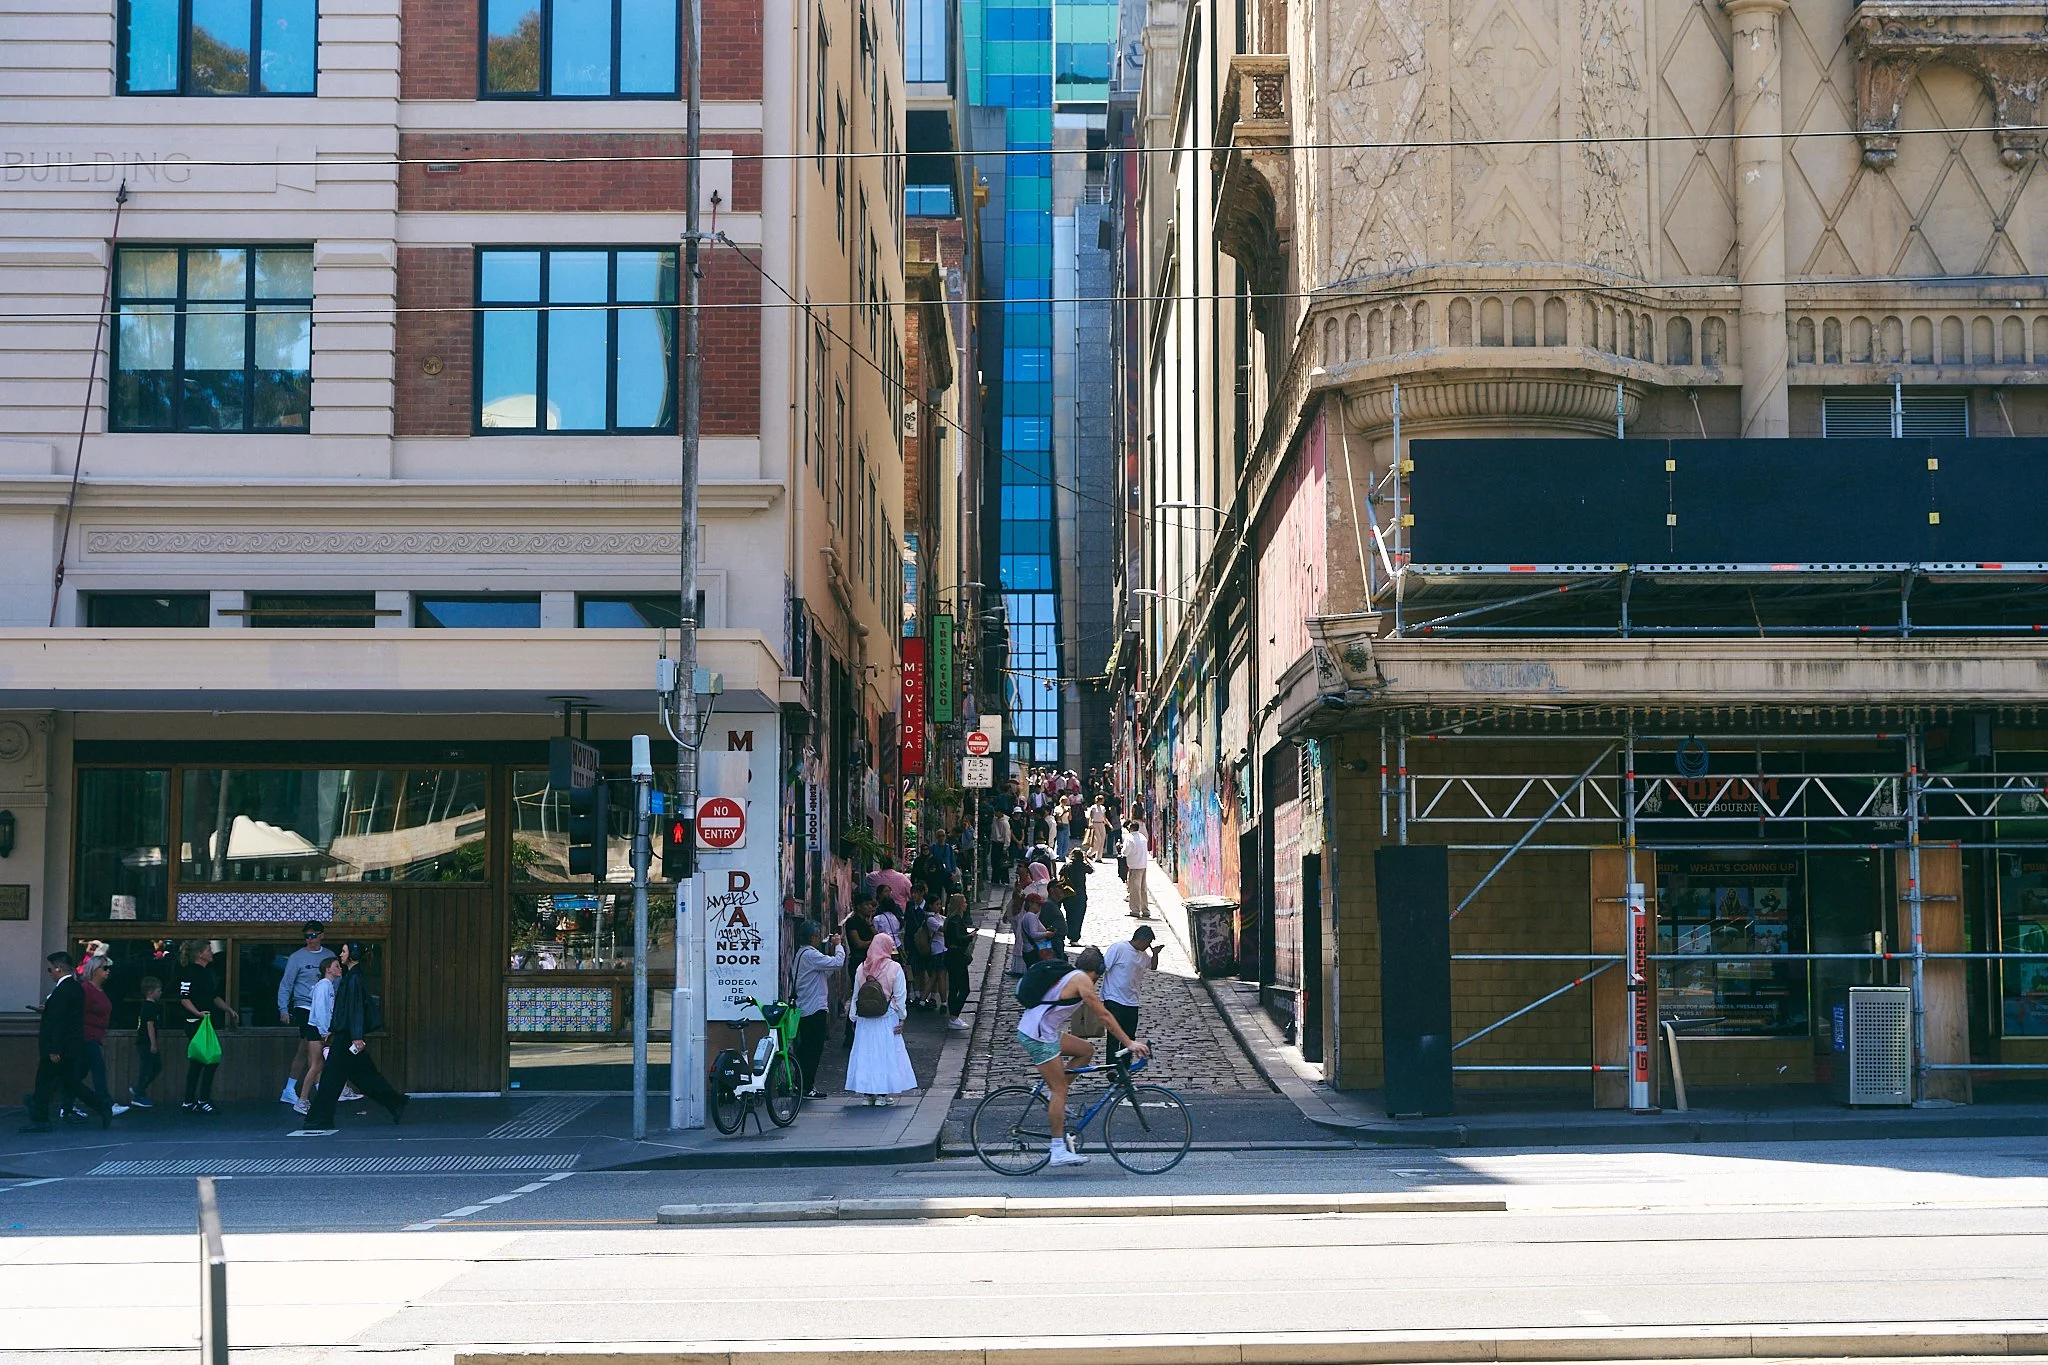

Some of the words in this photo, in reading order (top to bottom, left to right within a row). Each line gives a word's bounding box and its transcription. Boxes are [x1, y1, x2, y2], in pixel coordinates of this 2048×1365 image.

[3, 152, 192, 183] BUILDING
[939, 621, 948, 655] TRES
[939, 663, 948, 706] CINCO
[904, 662, 915, 749] MOVIDA
[1667, 777, 1781, 800] FORUM
[713, 806, 729, 817] NO
[704, 829, 738, 839] ENTRY
[1689, 863, 1731, 873] WHAT'S
[1732, 863, 1777, 872] COMING
[1779, 863, 1795, 871] UP
[716, 941, 761, 951] NEXT
[1636, 926, 1648, 976] ACCESS
[716, 955, 761, 965] DOOR
